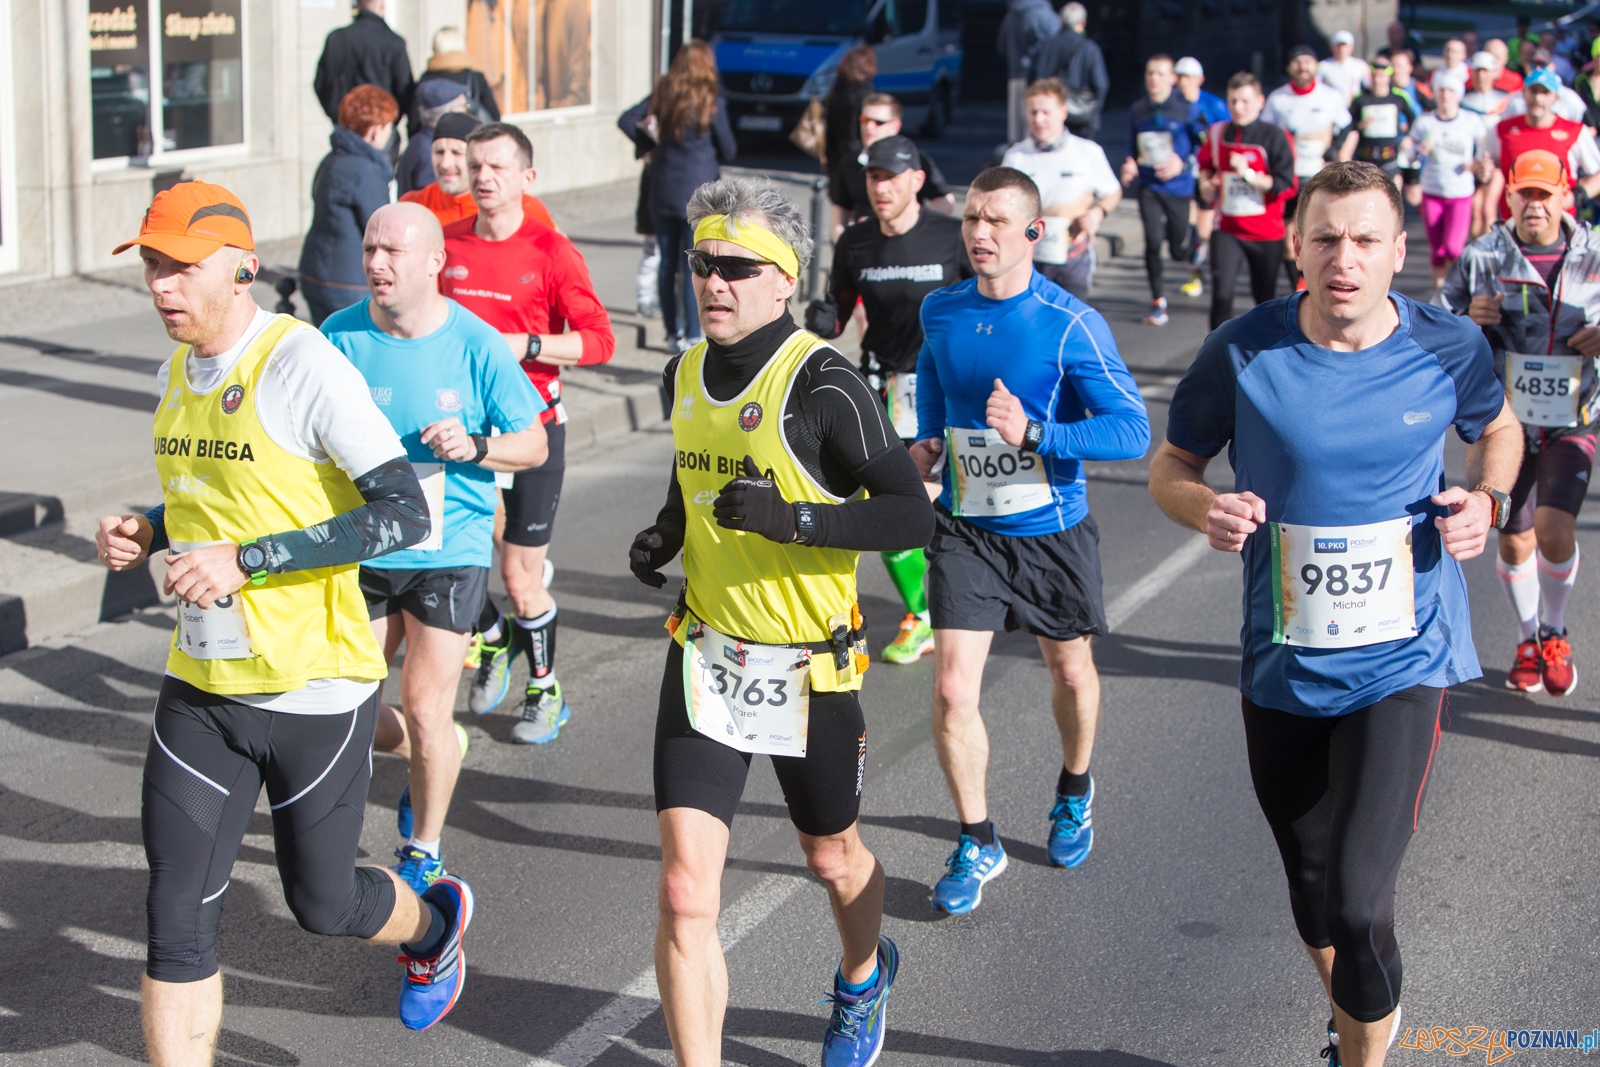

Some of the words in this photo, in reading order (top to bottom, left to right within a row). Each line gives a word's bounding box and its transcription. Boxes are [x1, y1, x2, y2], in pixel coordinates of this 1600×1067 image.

[165, 12, 200, 41] Skup
[493, 292, 512, 302] TEAM
[1515, 375, 1570, 396] 4835
[196, 439, 255, 462] BIEGA
[676, 449, 711, 472] BOŃ
[717, 455, 775, 480] BIEA
[958, 449, 1036, 478] 10605
[1328, 541, 1345, 549] PKO
[1301, 557, 1393, 596] 9837
[1333, 599, 1367, 610] Michał
[183, 612, 205, 623] Robert
[708, 663, 788, 706] 3763
[733, 705, 758, 718] Marek
